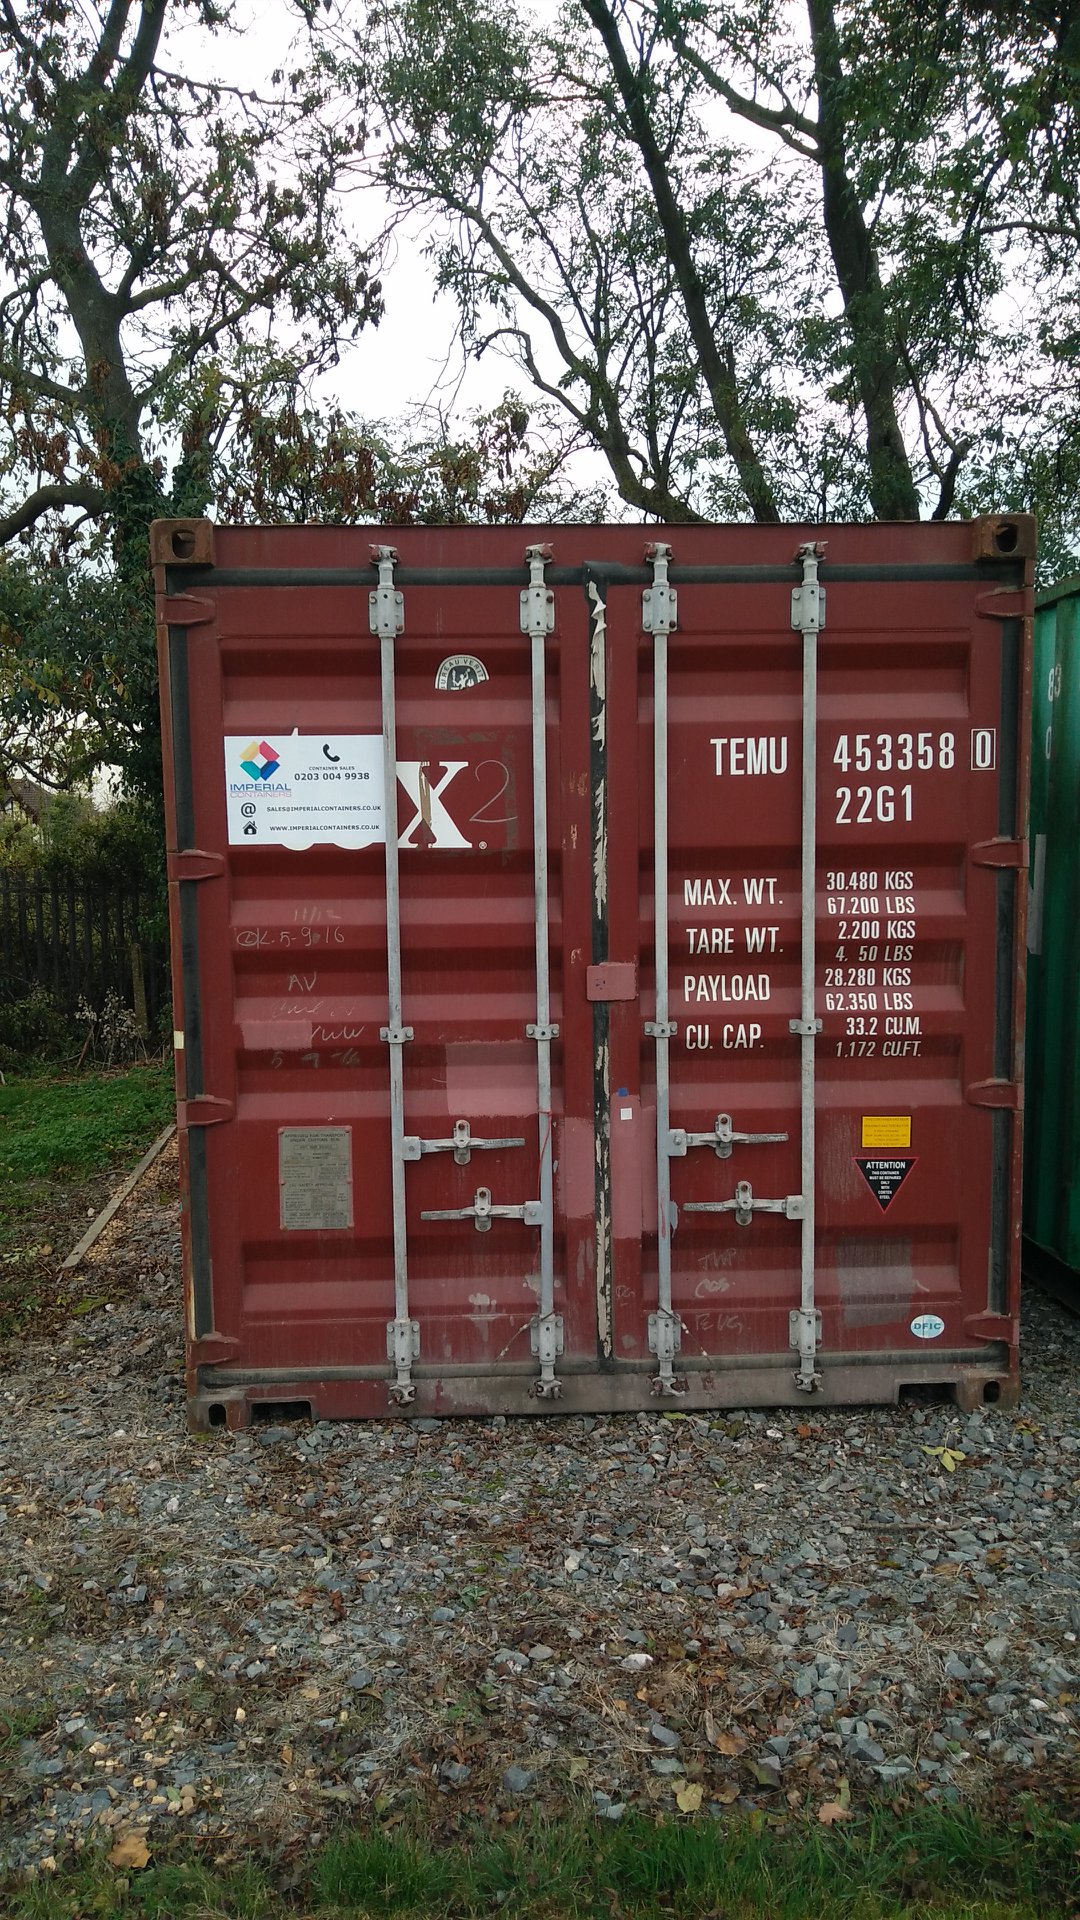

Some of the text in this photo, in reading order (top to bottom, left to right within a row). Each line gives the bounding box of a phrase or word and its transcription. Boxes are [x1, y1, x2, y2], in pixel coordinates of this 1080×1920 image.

[709, 730, 992, 776] TEMU 453358 0
[294, 772, 370, 781] 0203 004 9938
[229, 783, 292, 791] IMPERIAL
[835, 784, 912, 824] 22G1
[885, 871, 914, 890] KGS
[683, 877, 783, 906] MAX. WT.
[885, 896, 916, 914] LBS
[887, 920, 916, 939] KGS
[686, 926, 784, 954] TARE WT.
[884, 945, 914, 962] LBS
[882, 967, 912, 986] KGS
[684, 974, 771, 1002] PAYLOAD
[883, 992, 914, 1010] LBS
[846, 1016, 923, 1036] 33.2 CU.M.
[685, 1023, 764, 1050] CU. CAP.
[866, 1161, 905, 1169] ATTENTION
[913, 1322, 942, 1330] DFIC
